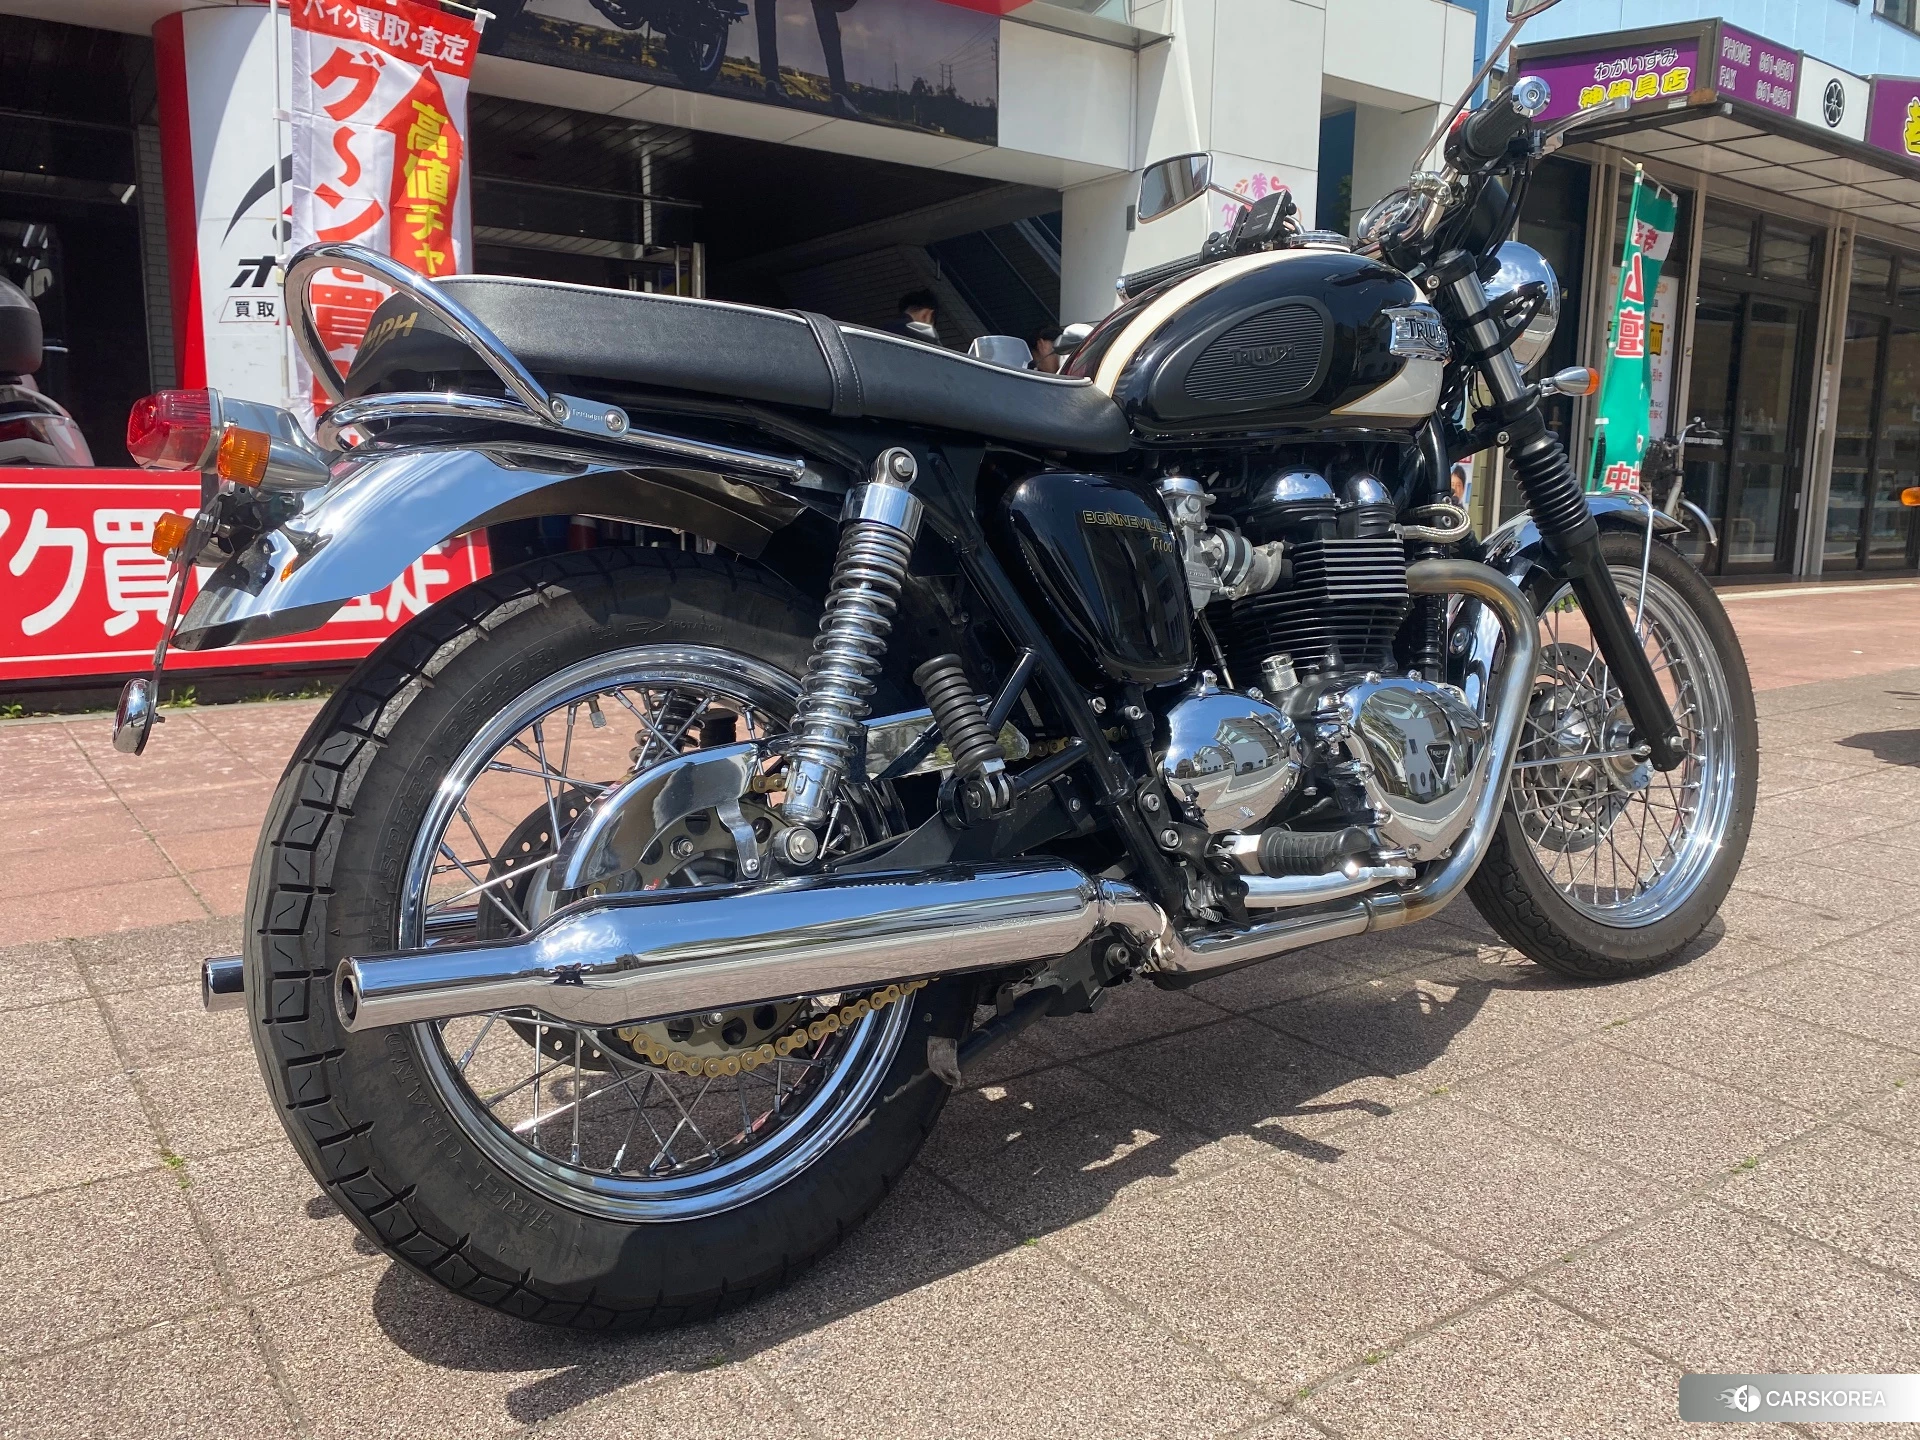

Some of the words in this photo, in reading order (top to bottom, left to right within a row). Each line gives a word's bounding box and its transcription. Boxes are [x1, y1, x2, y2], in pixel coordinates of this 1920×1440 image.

[1722, 36, 1752, 66] PHONE
[1719, 65, 1737, 90] FAX
[235, 301, 275, 317] 買取
[1228, 343, 1296, 367] TRIUMPH
[1083, 510, 1169, 534] BONNEVILLE
[379, 755, 439, 887] SPEED
